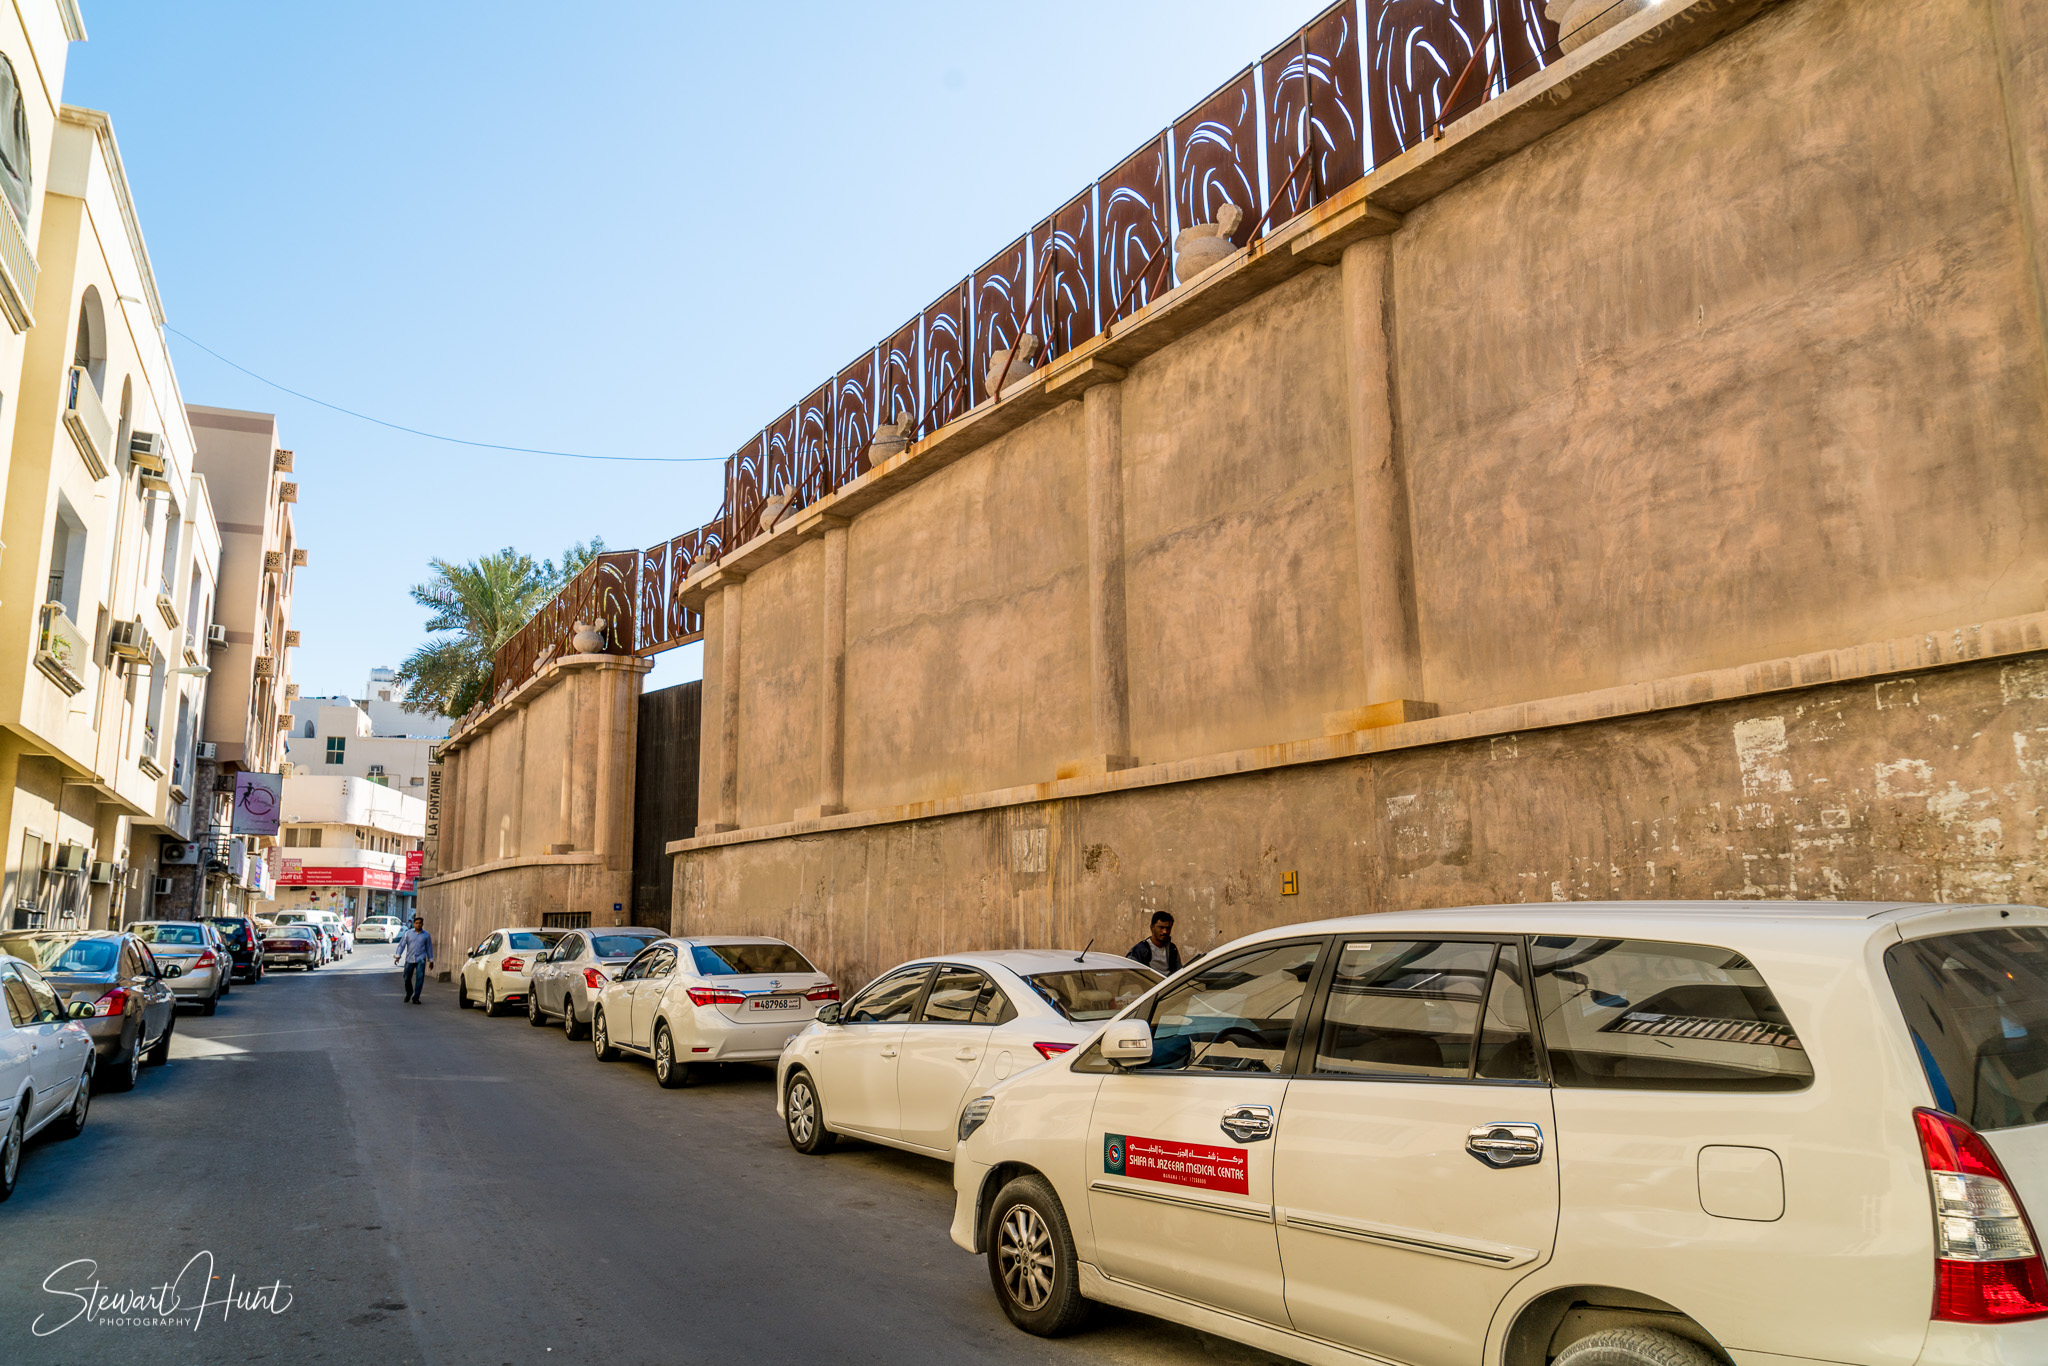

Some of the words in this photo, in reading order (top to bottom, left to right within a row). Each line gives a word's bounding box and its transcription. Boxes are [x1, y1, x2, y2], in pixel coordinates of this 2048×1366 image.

[428, 770, 442, 820] FONTAINE
[428, 823, 438, 836] LA
[1282, 872, 1294, 893] H
[760, 999, 788, 1009] 487968
[1158, 1146, 1188, 1158] الجزيرة
[1189, 1150, 1216, 1160] شفاء
[1217, 1152, 1244, 1164] مركز
[1129, 1155, 1147, 1166] SHIFA
[1148, 1158, 1156, 1168] AL
[1156, 1159, 1185, 1172] JAZEERA
[1186, 1162, 1216, 1176] MEDICAL
[1217, 1166, 1244, 1180] CENTRE
